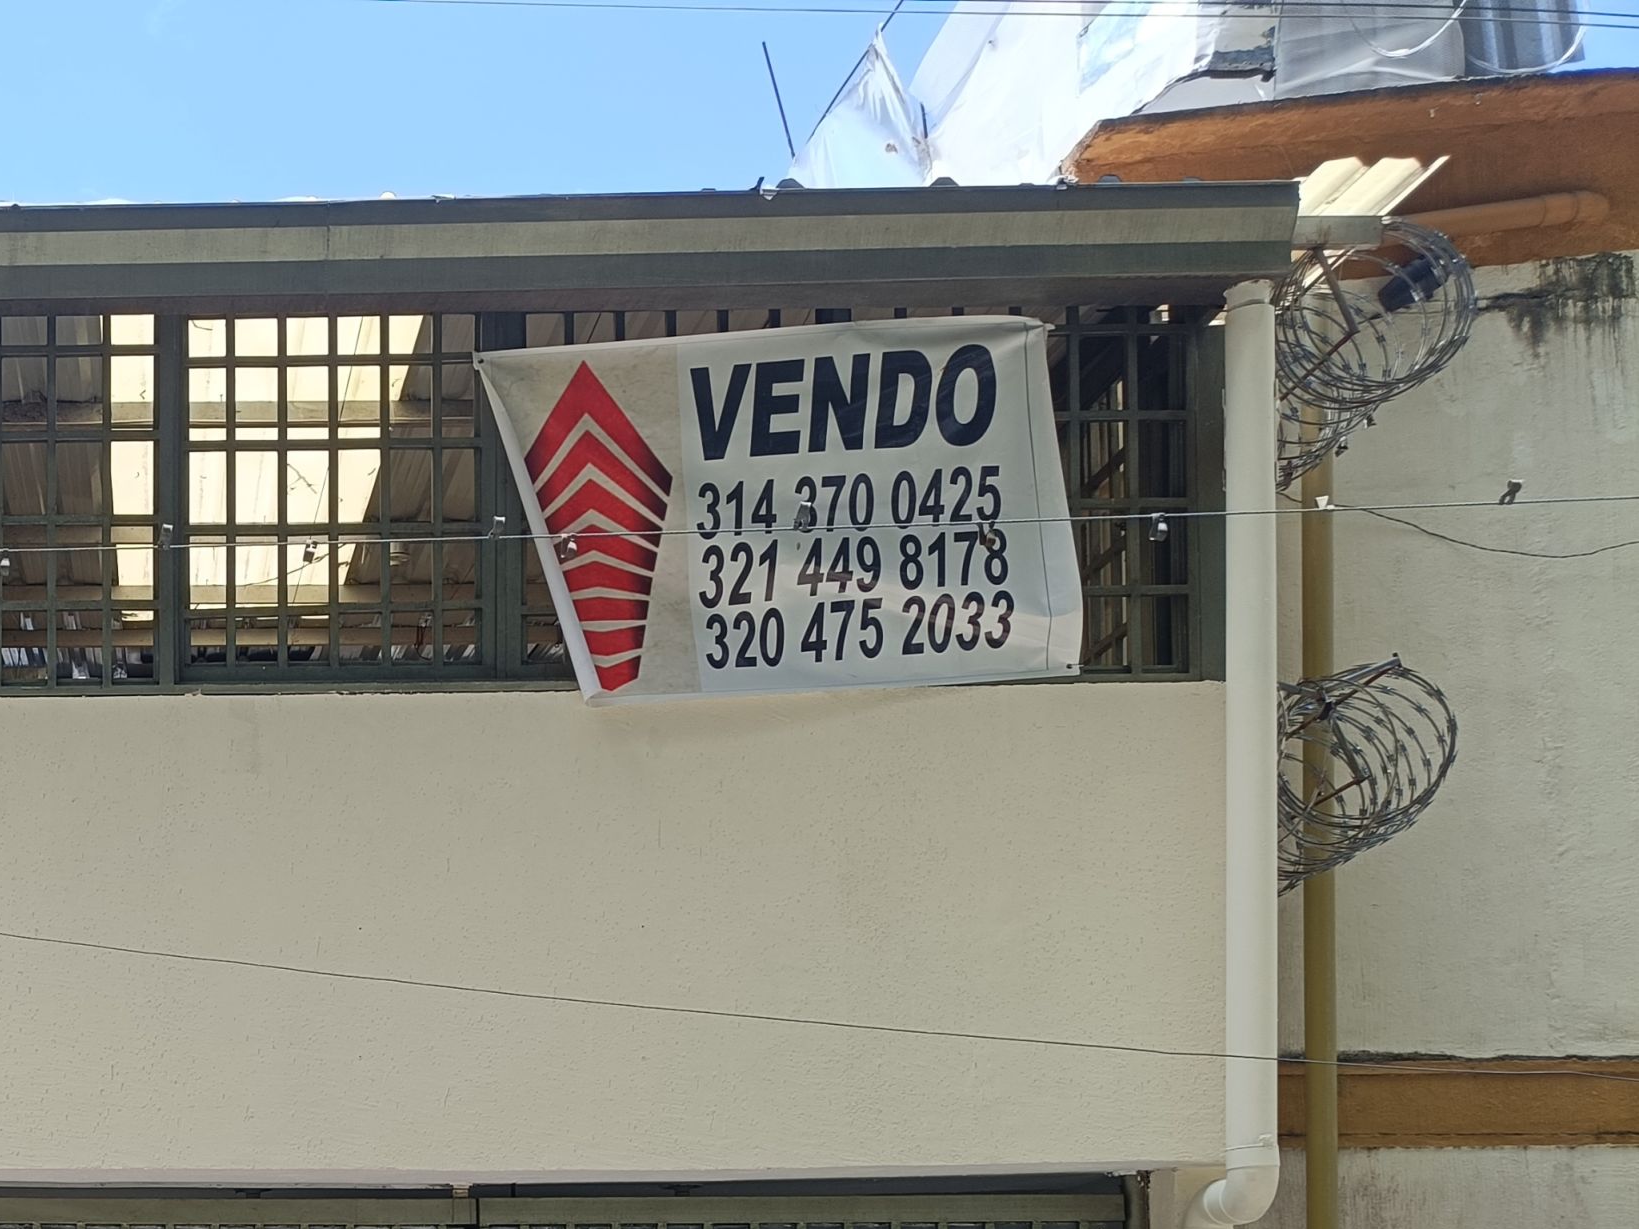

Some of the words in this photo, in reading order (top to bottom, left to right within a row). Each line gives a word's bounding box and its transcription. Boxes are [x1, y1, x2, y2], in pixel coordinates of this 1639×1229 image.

[690, 344, 997, 461] VENDO
[697, 478, 777, 540] 314
[794, 473, 875, 534] 370
[891, 465, 1002, 530] 0425
[699, 541, 779, 609] 321
[798, 536, 882, 597] 449
[899, 529, 1009, 591] 8178
[706, 608, 784, 669] 320
[801, 598, 884, 663] 475
[902, 591, 1014, 656] 2033
